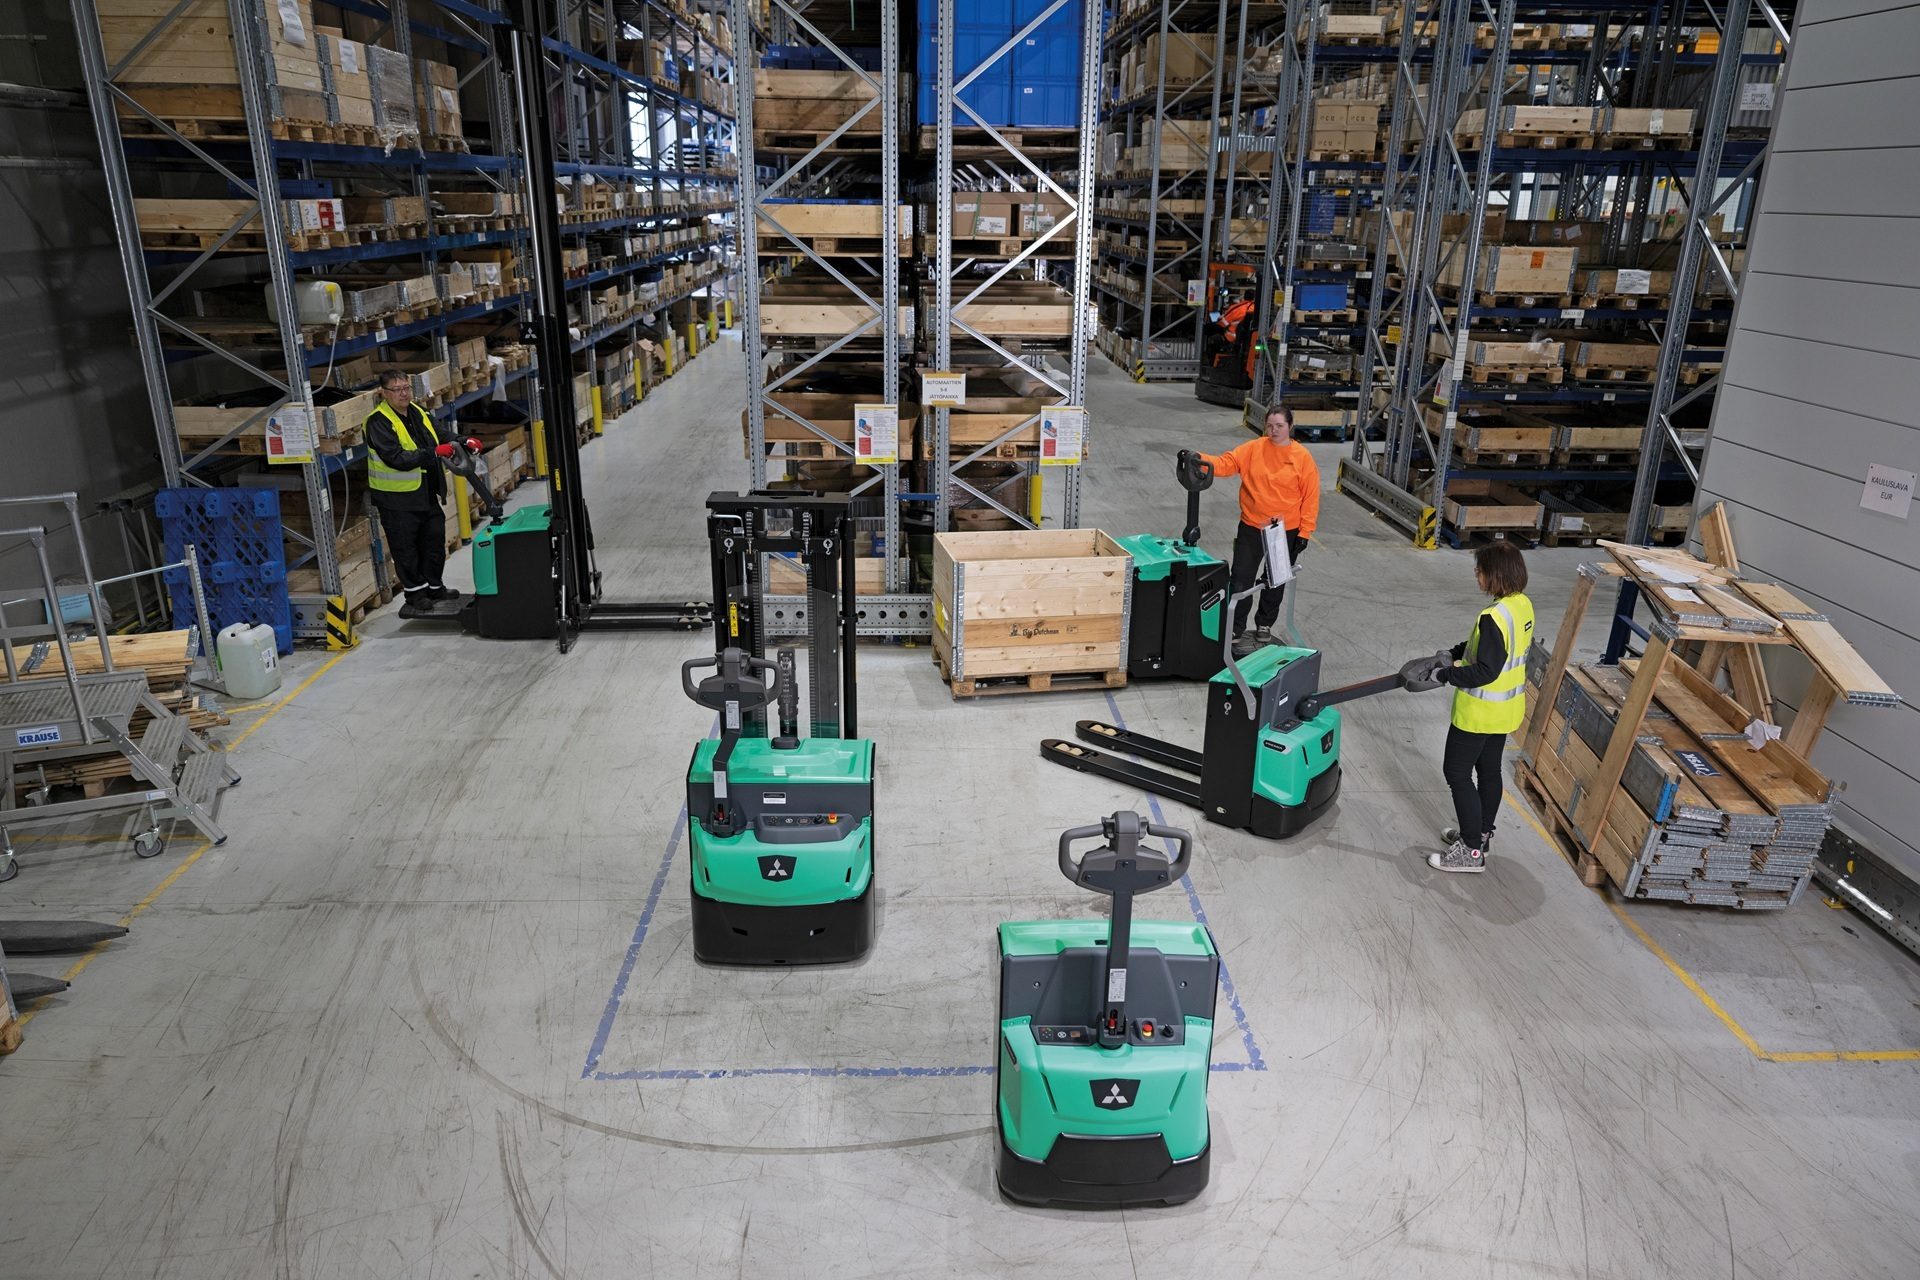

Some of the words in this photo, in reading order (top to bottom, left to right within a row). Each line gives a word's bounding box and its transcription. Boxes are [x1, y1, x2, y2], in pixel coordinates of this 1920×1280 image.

[1871, 476, 1909, 491] KAULUSLAVA
[1881, 491, 1893, 500] EUR
[19, 732, 60, 744] KRAUSE
